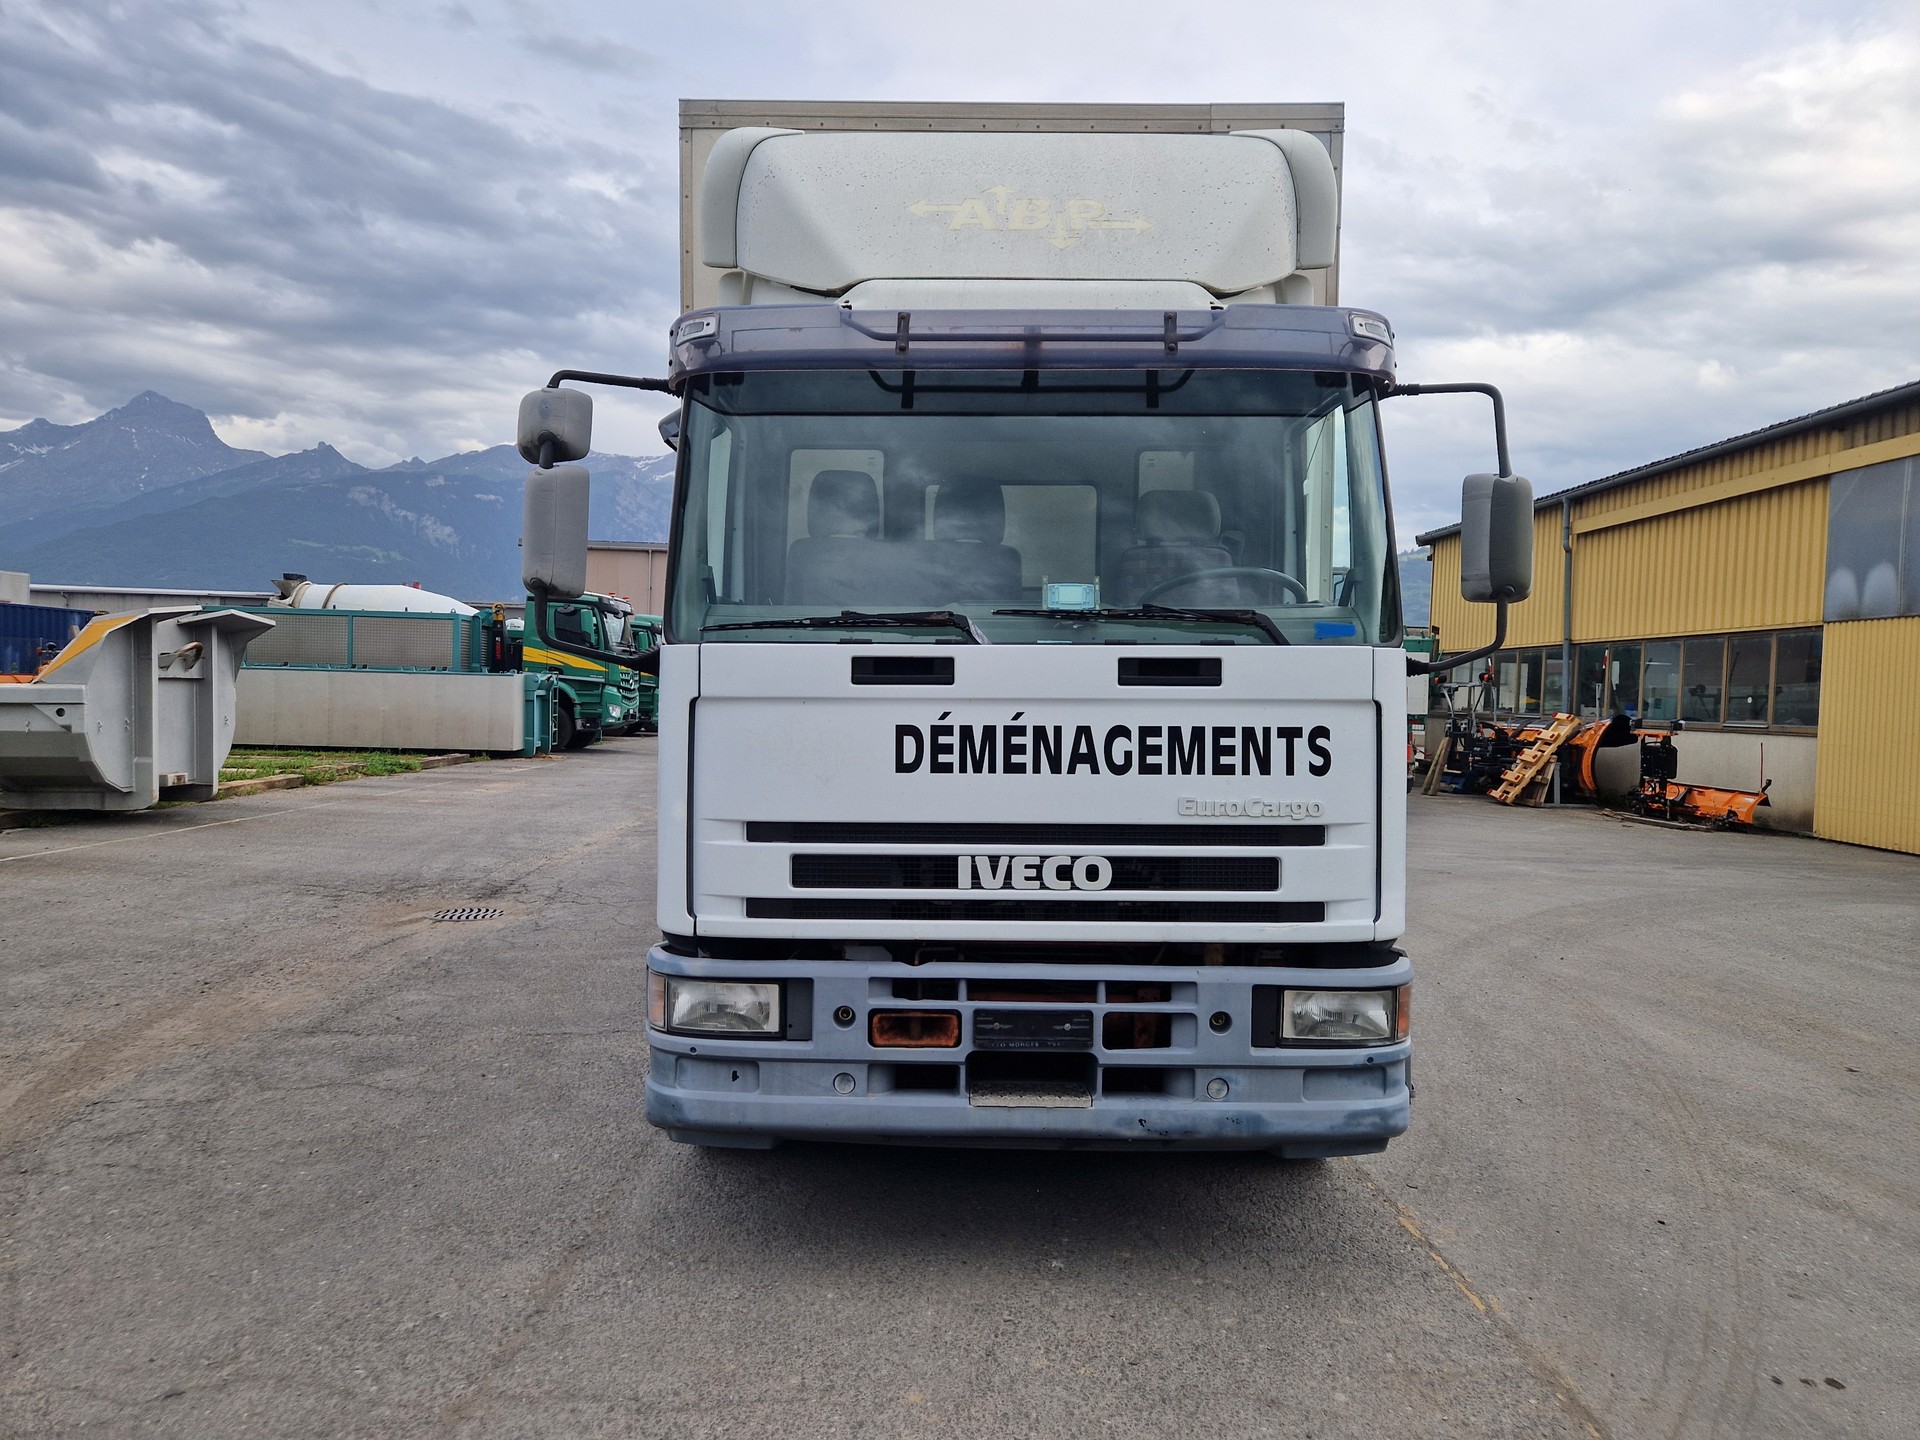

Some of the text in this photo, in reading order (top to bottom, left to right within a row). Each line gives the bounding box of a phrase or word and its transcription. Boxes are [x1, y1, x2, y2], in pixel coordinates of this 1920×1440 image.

[950, 198, 1105, 230] ABP
[895, 711, 1331, 777] DÉMÉNAGEMENTS
[1178, 797, 1324, 820] EuroCargo
[958, 855, 1112, 891] IVECO
